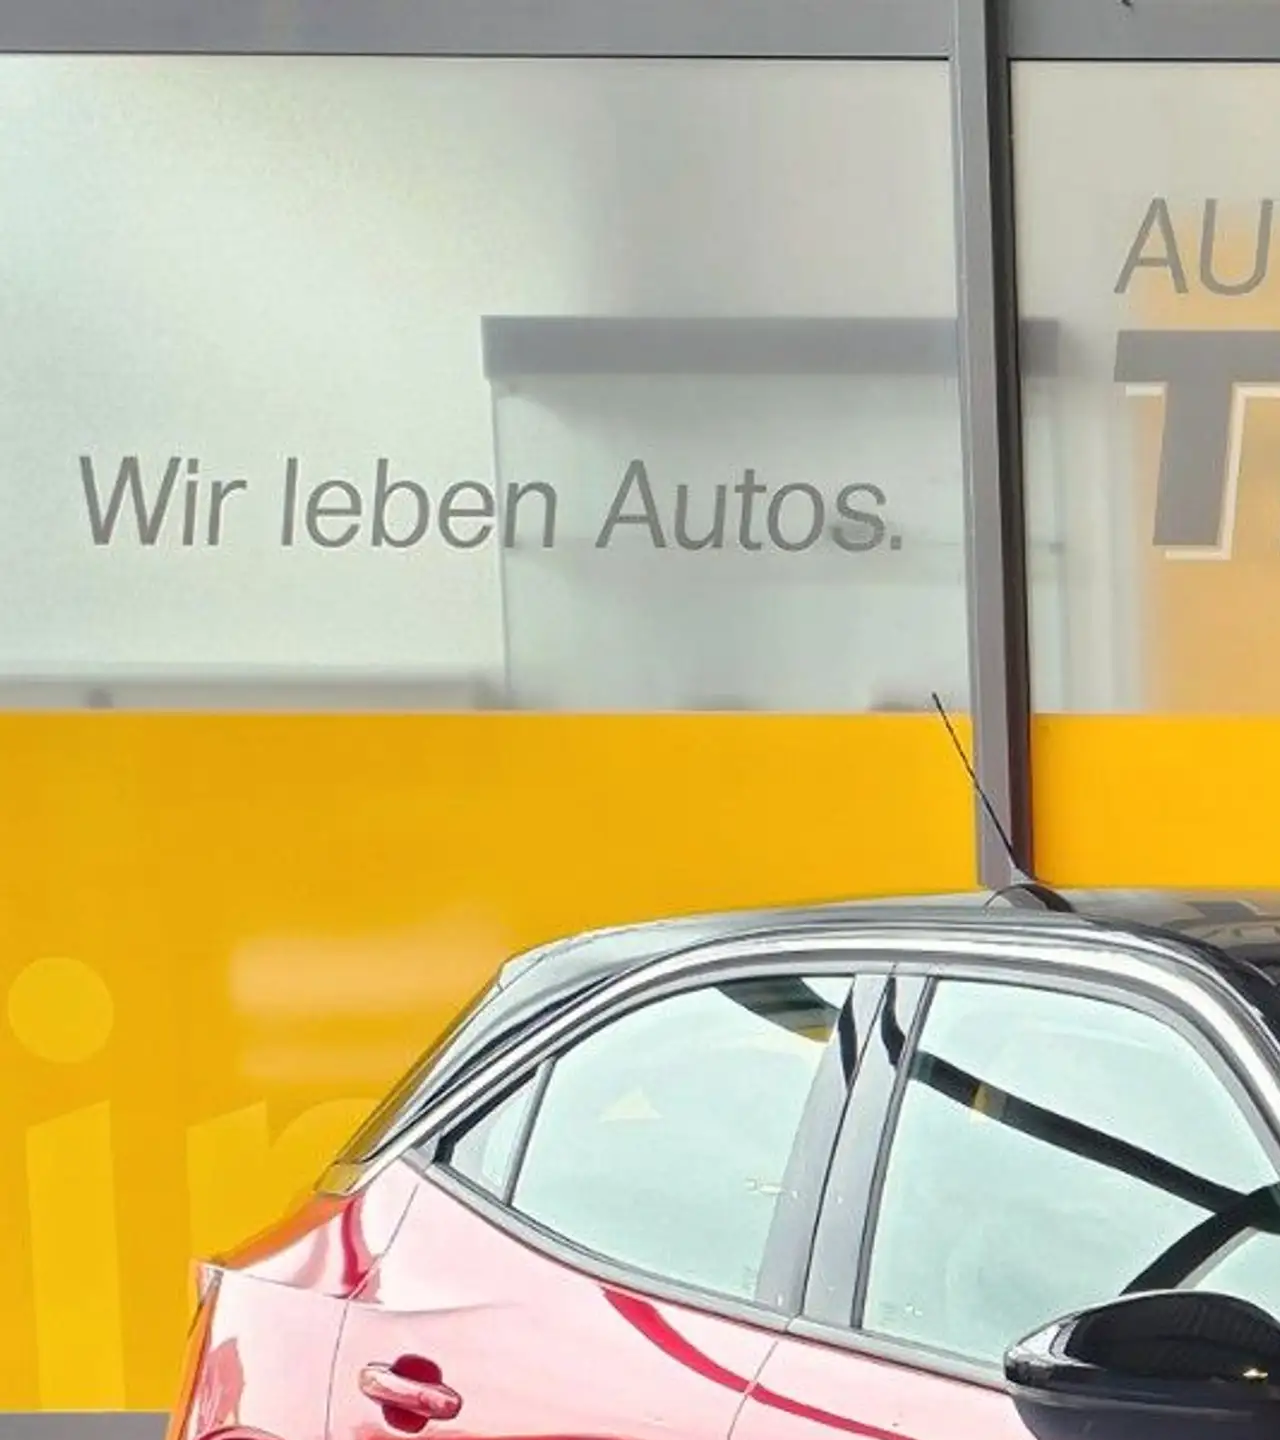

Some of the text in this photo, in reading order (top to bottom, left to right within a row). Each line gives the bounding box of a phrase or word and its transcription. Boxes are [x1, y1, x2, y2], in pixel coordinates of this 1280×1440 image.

[80, 455, 903, 551] Wir leben Autos.
